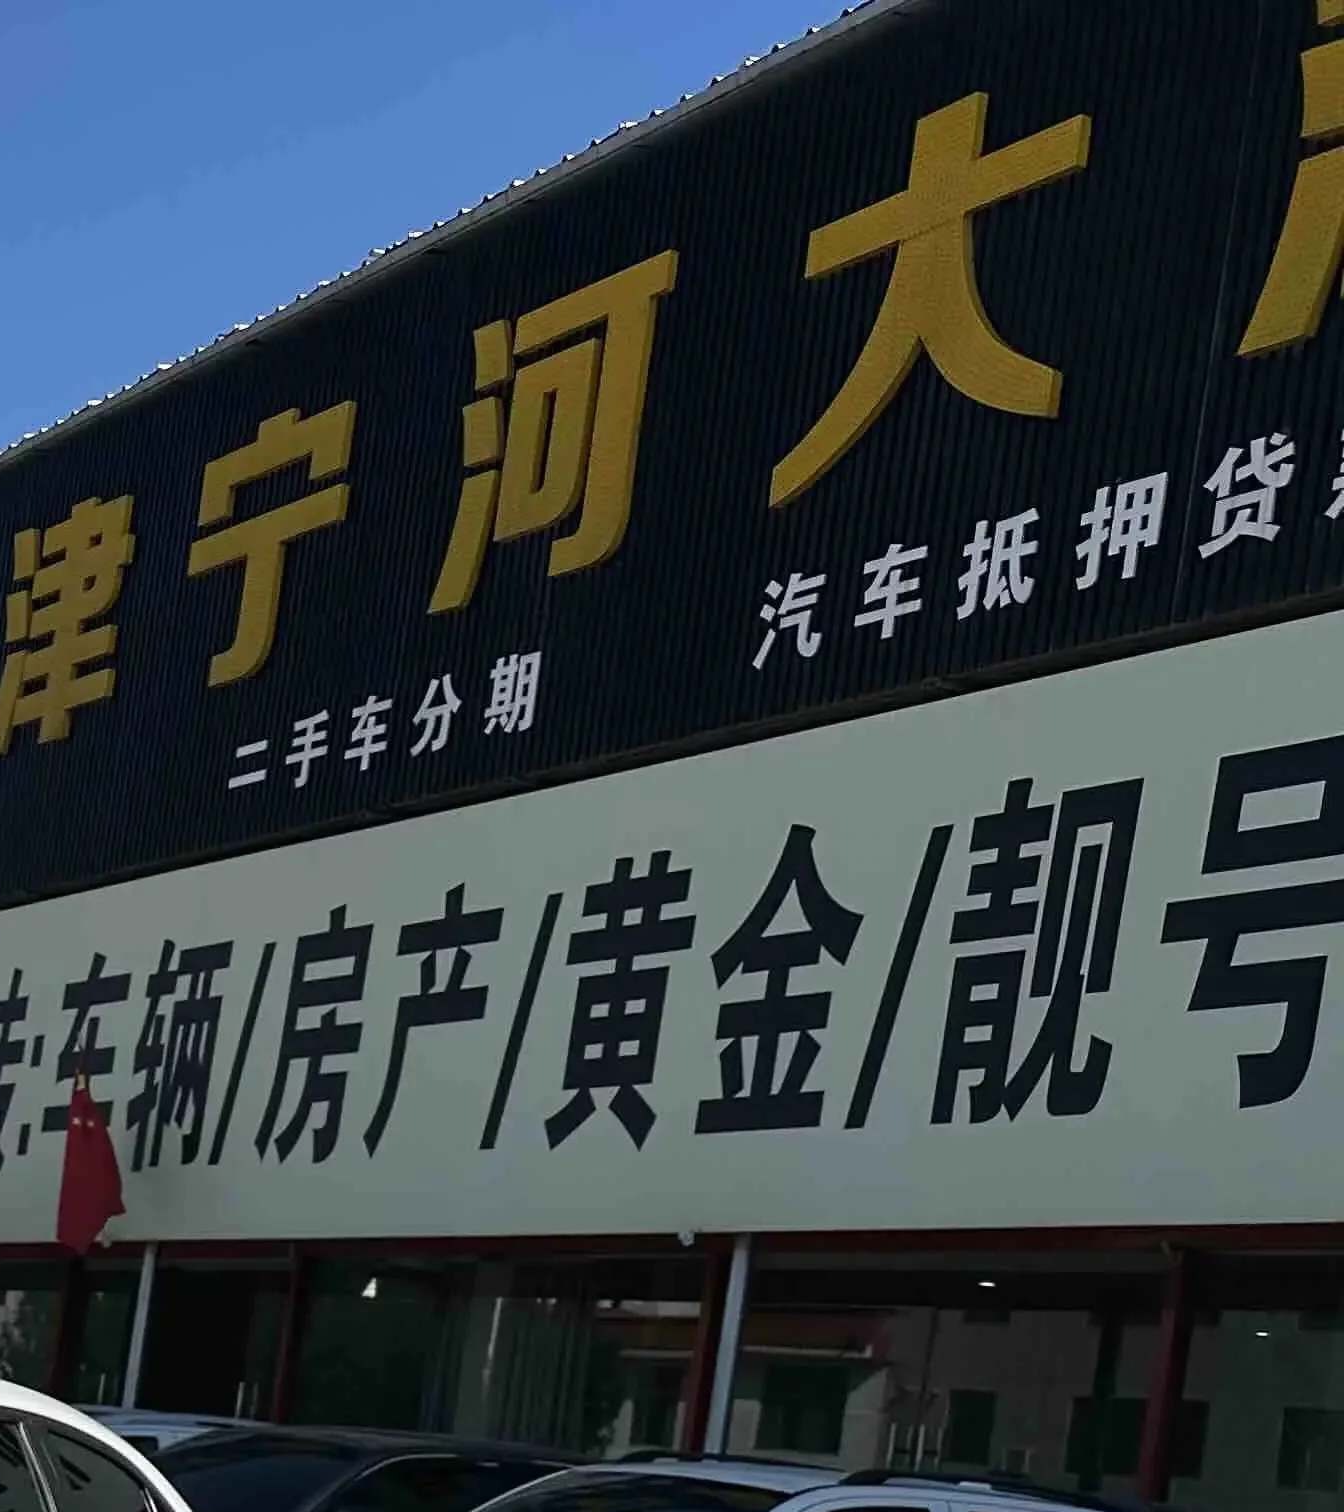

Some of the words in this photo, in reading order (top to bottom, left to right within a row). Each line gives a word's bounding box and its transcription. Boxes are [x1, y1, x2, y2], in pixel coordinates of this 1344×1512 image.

[753, 428, 1344, 670] 汽车抵押贷
[227, 650, 543, 790] 二手车分期
